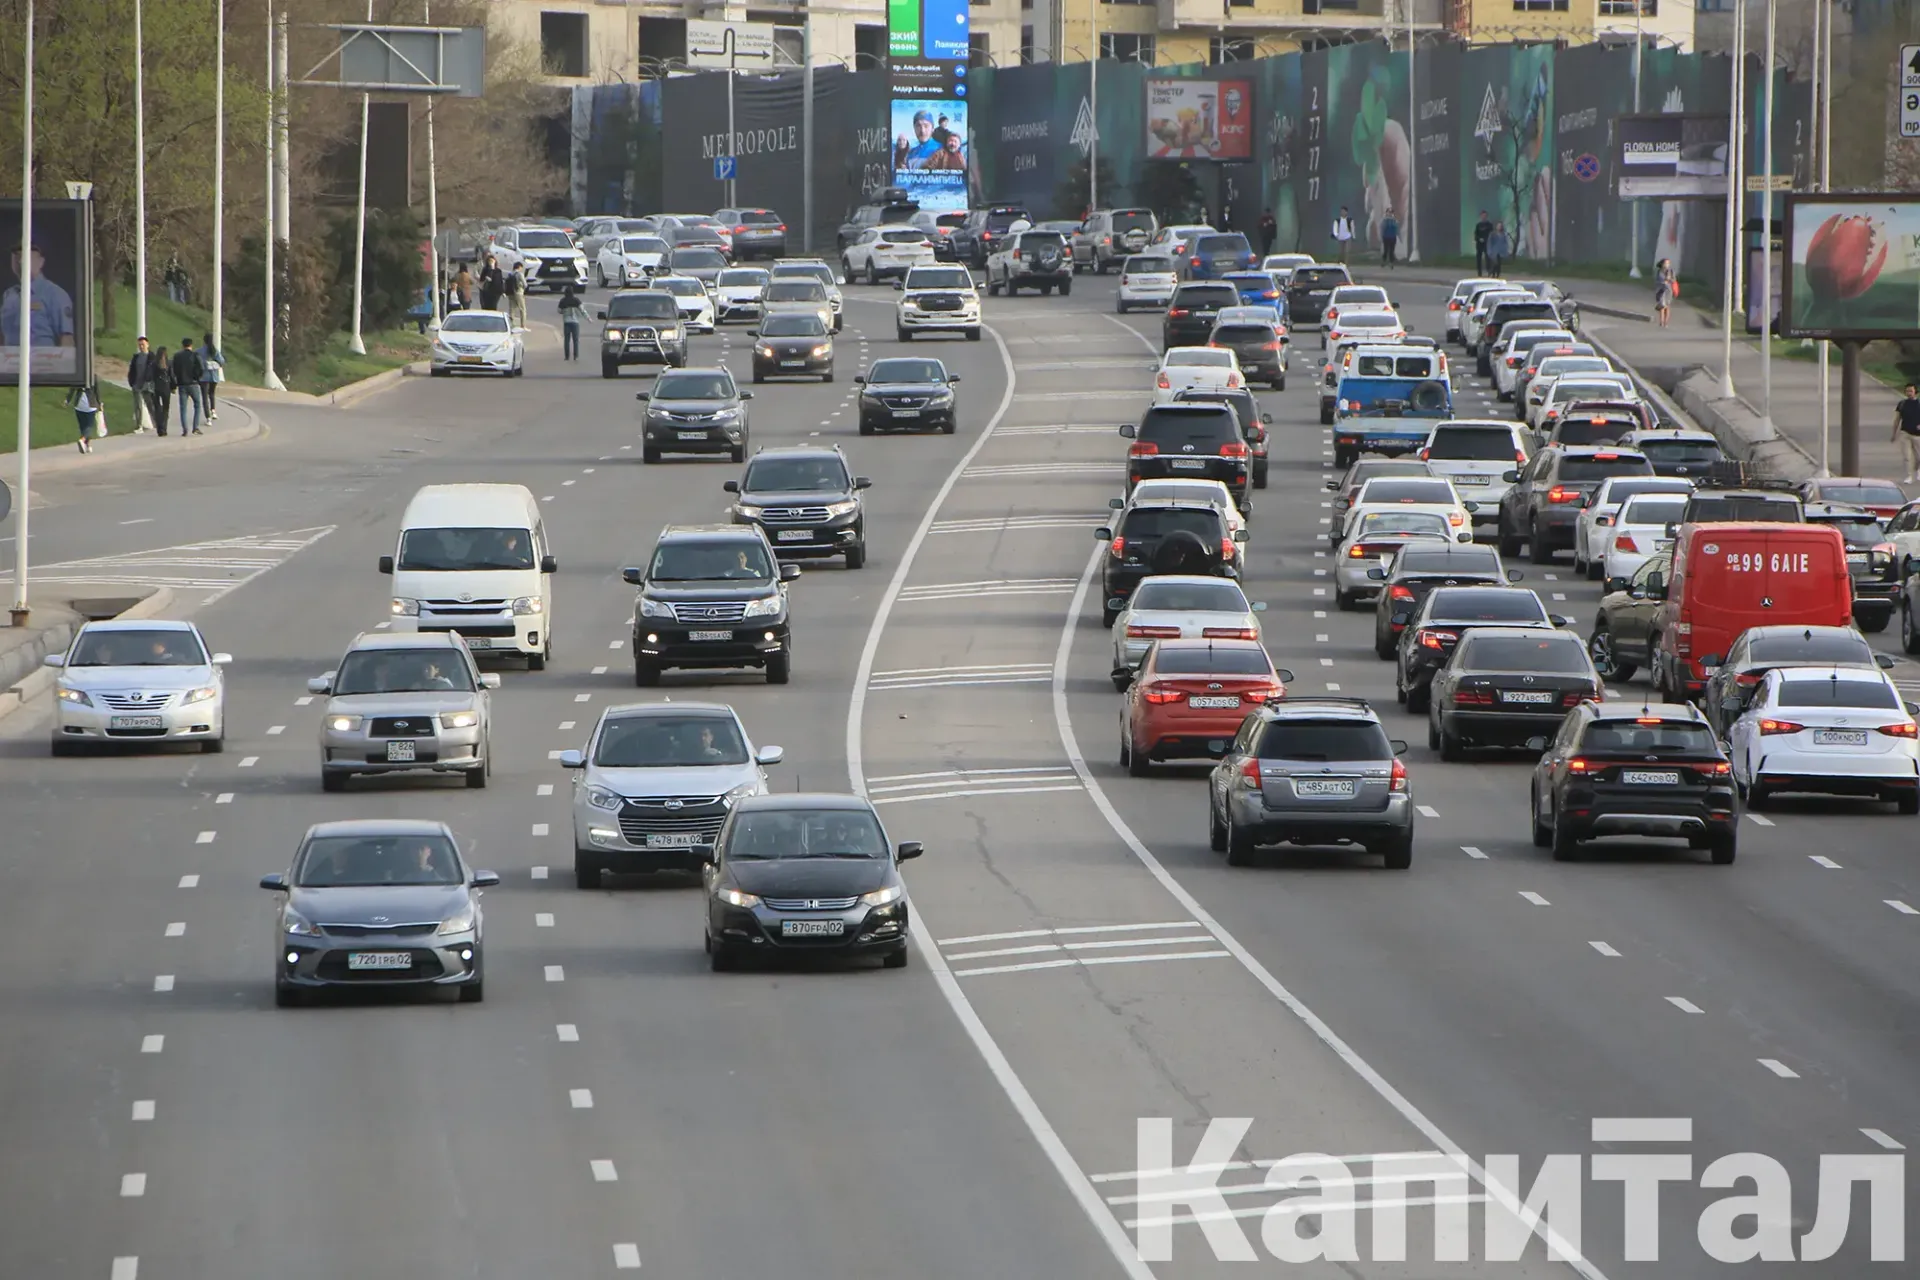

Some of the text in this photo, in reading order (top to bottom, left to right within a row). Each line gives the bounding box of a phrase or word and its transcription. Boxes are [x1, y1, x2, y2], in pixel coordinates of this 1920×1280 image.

[1312, 86, 1318, 110] 2
[1624, 142, 1680, 152] FLORYA HOME
[1014, 154, 1037, 171] ОКНА
[1727, 554, 1739, 564] 08
